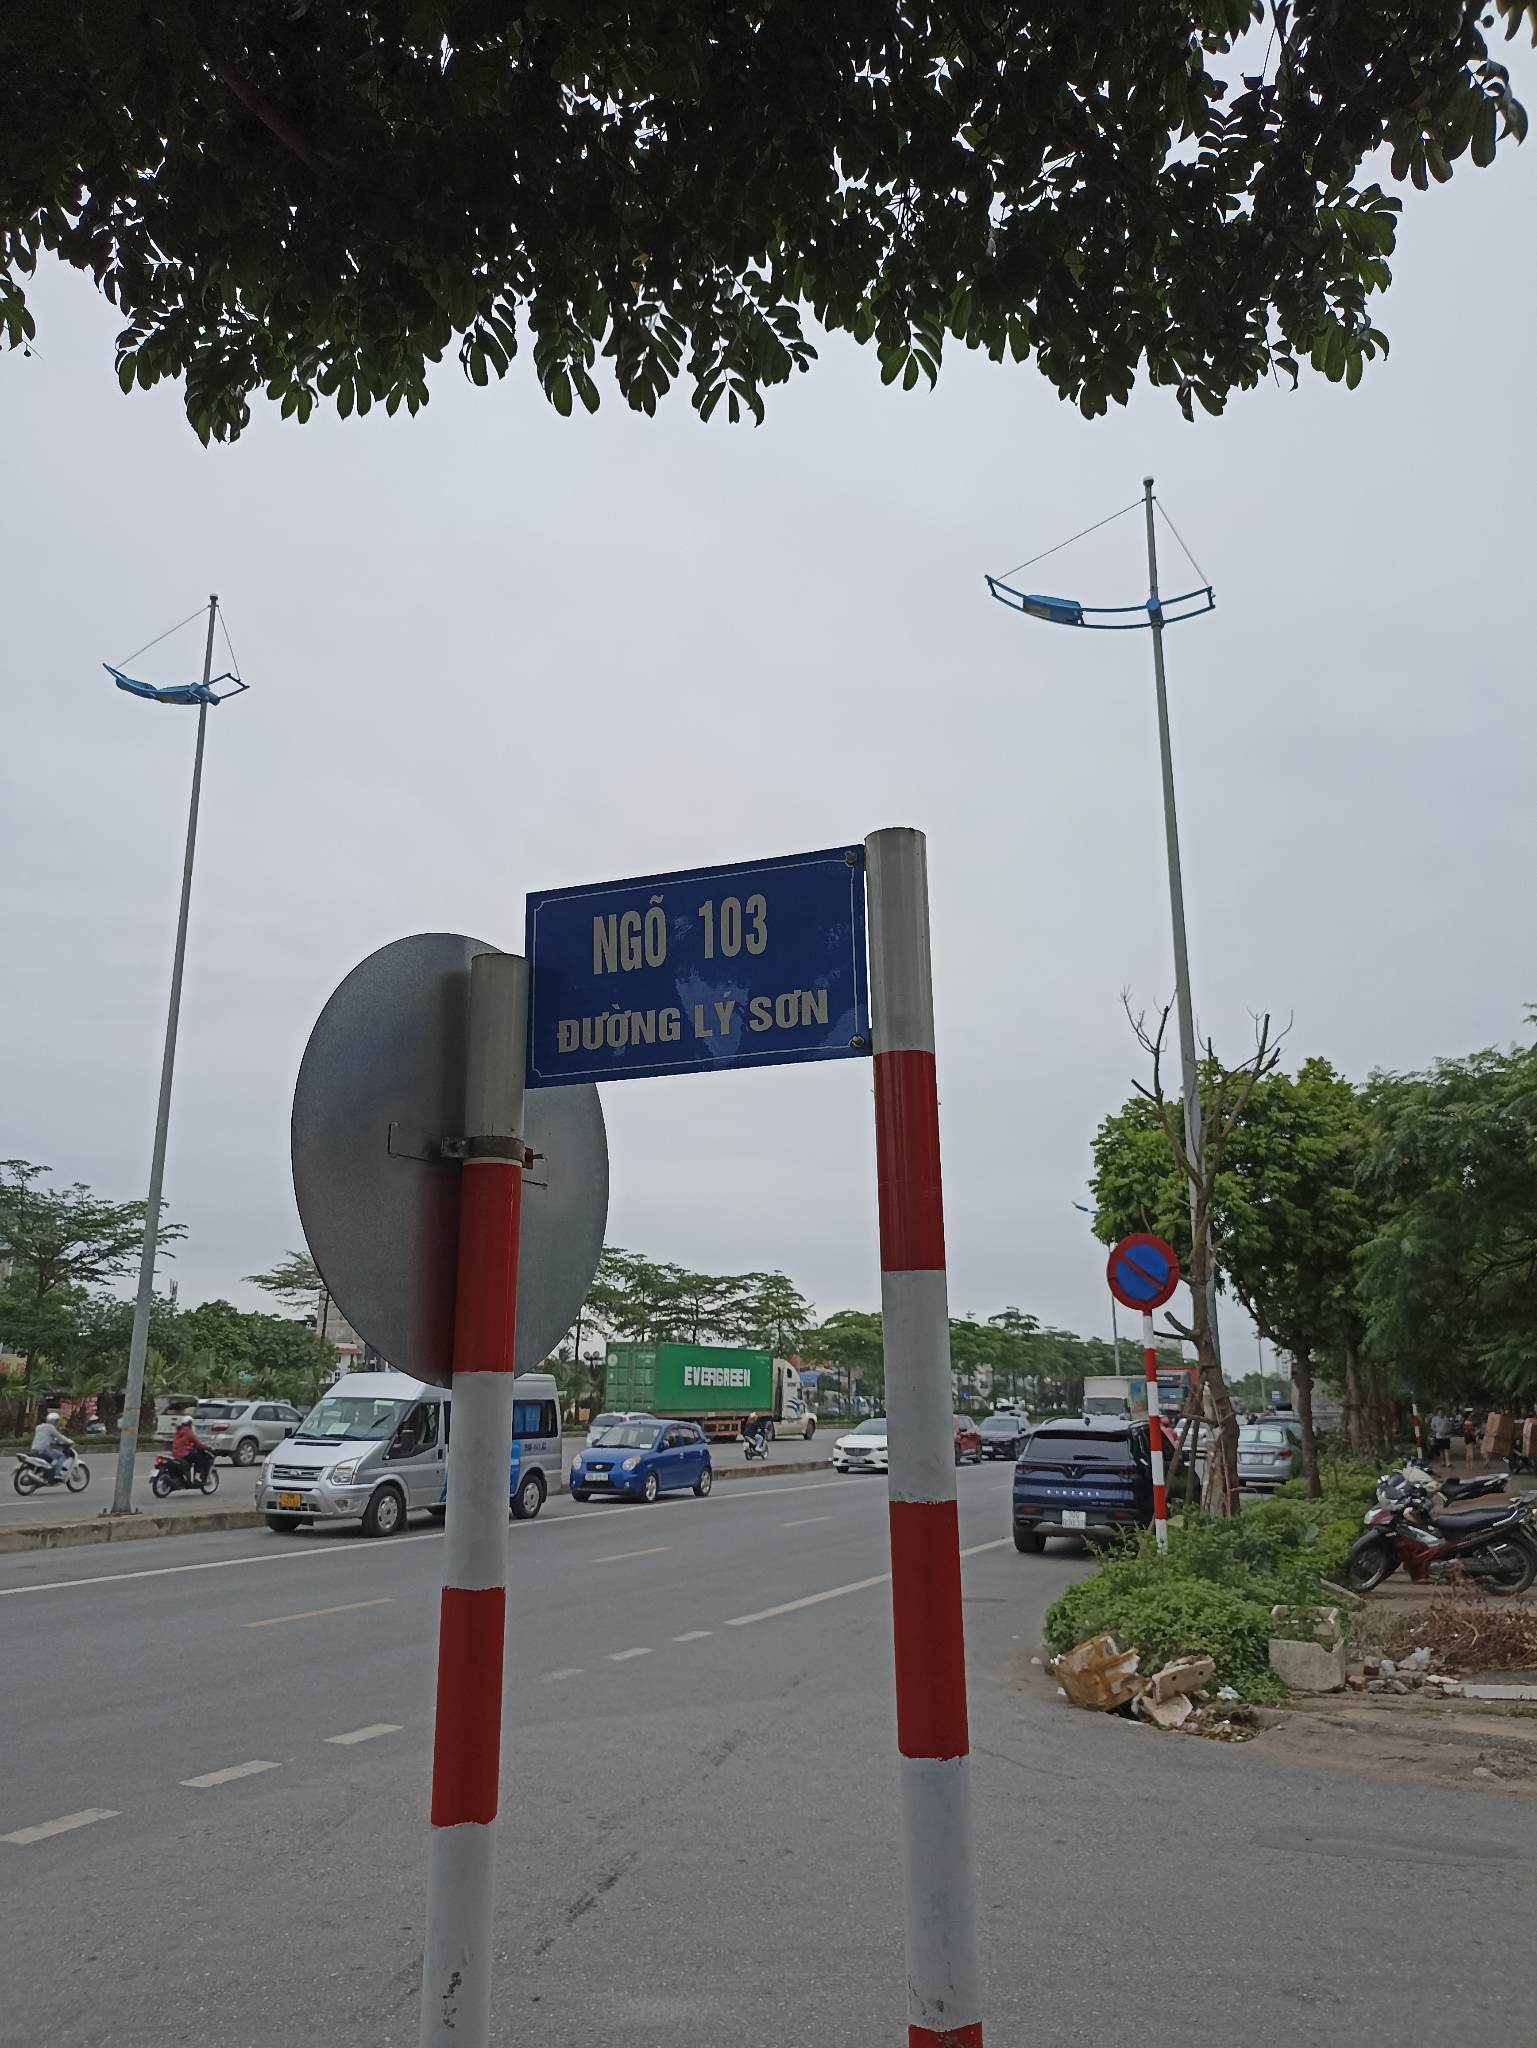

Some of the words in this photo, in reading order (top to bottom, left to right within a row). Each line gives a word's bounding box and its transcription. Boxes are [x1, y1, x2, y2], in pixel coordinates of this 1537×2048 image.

[592, 894, 667, 976] NGÕ
[698, 893, 768, 960] 103
[556, 1003, 682, 1053] ĐƯỜNG
[694, 990, 736, 1039] LÝ
[749, 988, 829, 1032] SƠN
[684, 1366, 751, 1387] EVERGREEN
